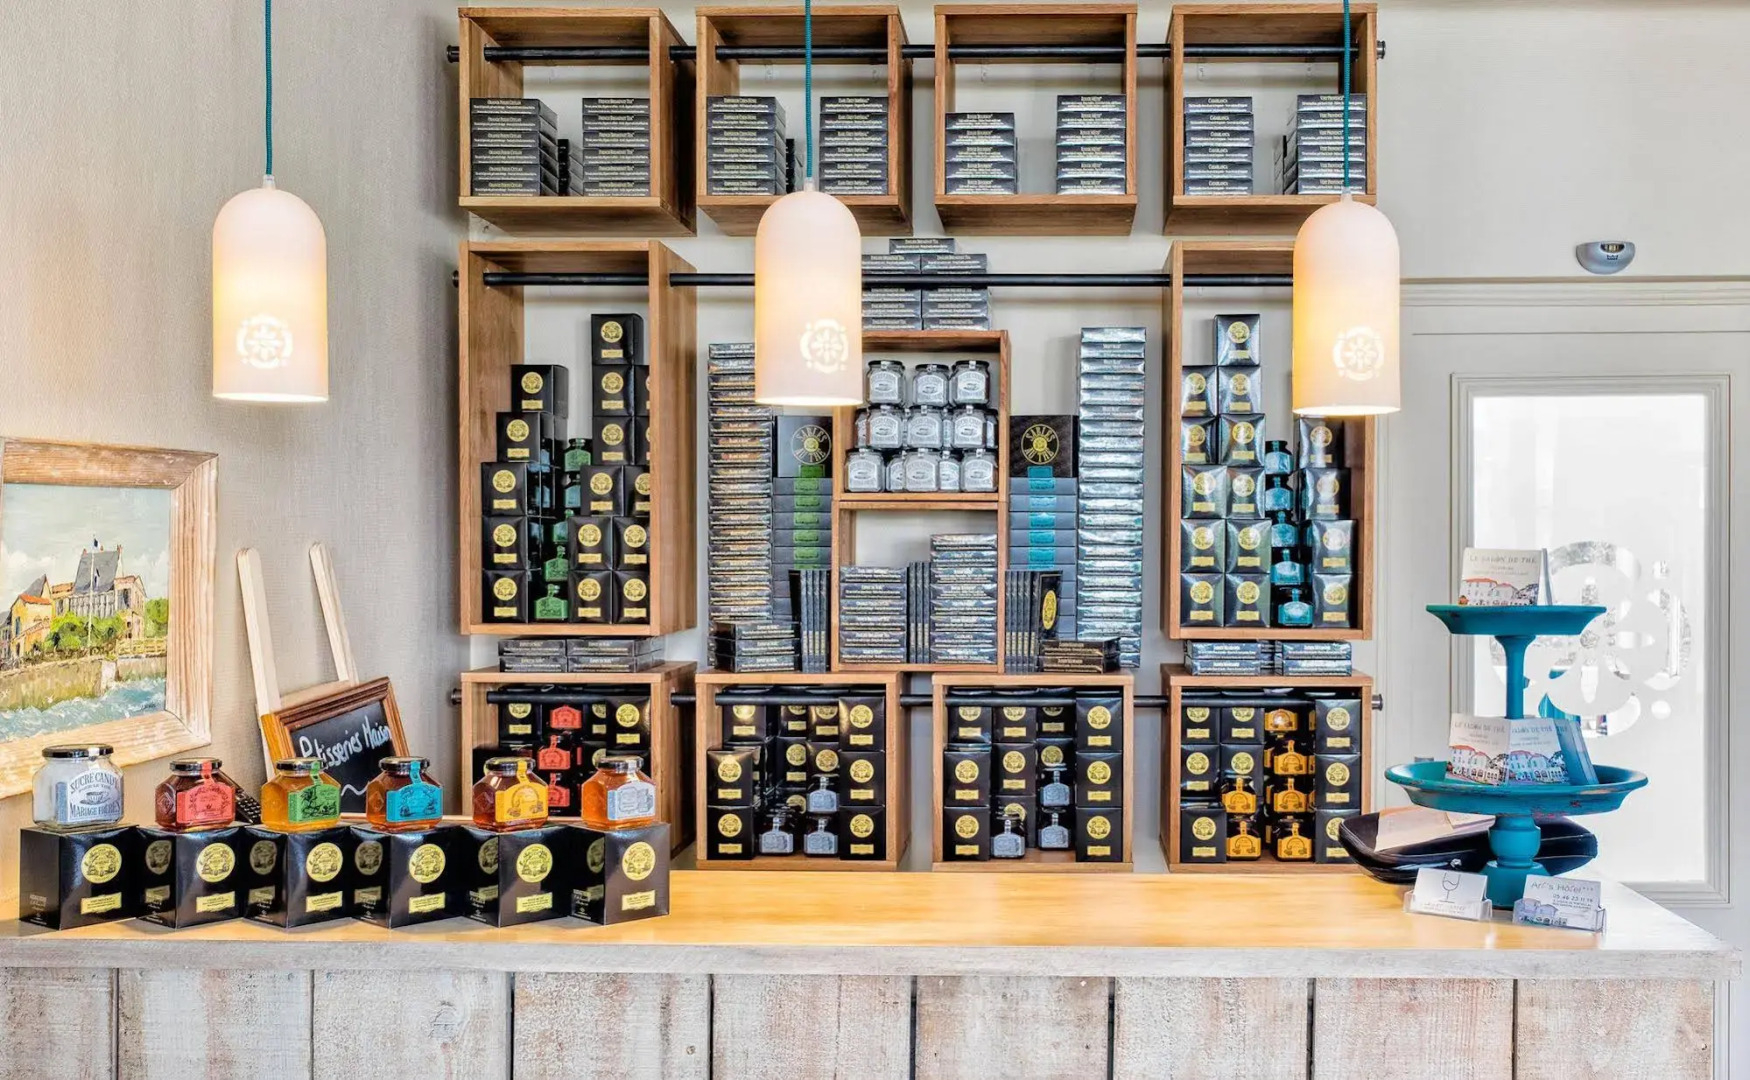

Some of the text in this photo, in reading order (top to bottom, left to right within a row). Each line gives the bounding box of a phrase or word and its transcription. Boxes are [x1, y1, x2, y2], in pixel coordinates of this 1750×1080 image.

[300, 729, 363, 769] Ptisseries
[70, 772, 94, 794] SUCRE
[70, 802, 97, 818] MARIAGE
